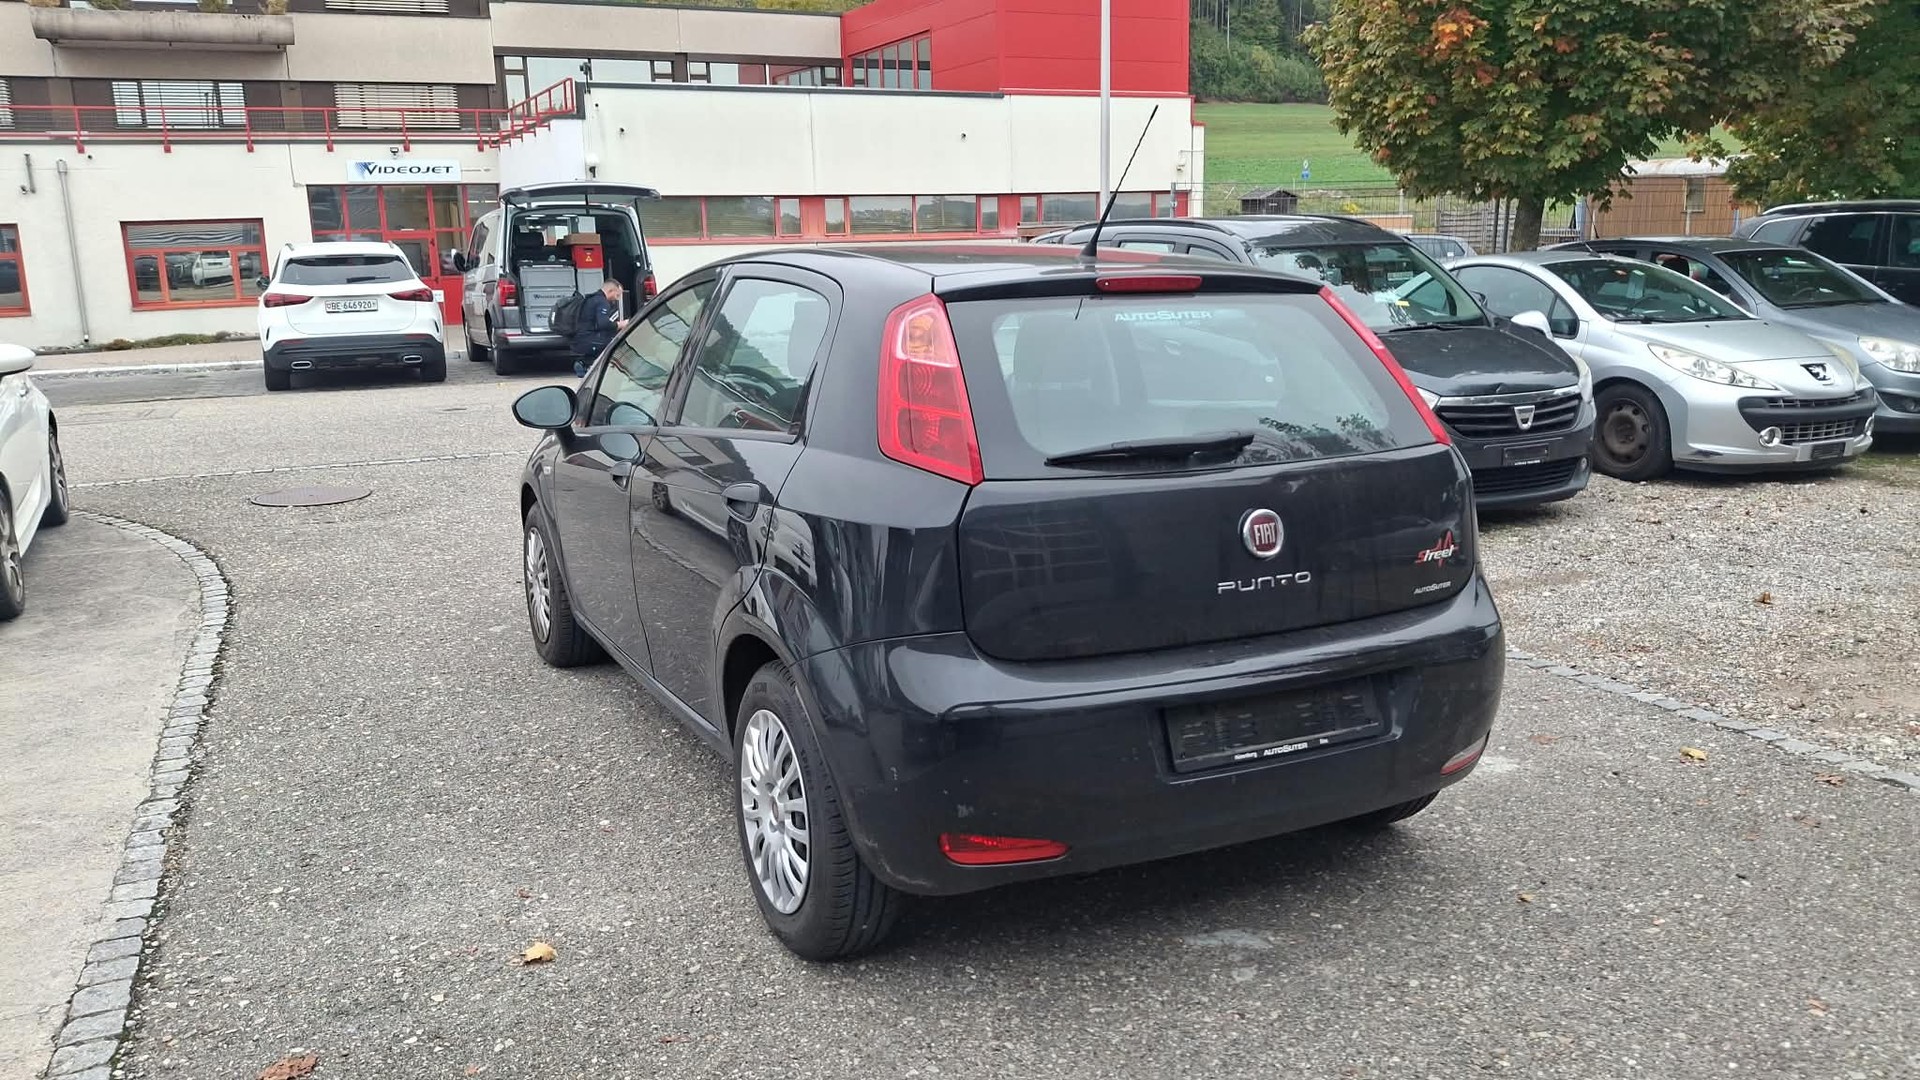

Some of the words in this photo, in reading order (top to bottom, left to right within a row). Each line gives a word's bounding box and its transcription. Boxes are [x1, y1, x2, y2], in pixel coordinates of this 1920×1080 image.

[363, 162, 454, 175] VIDEOJET
[1253, 522, 1276, 546] FIAT
[1217, 571, 1311, 595] PUNTO
